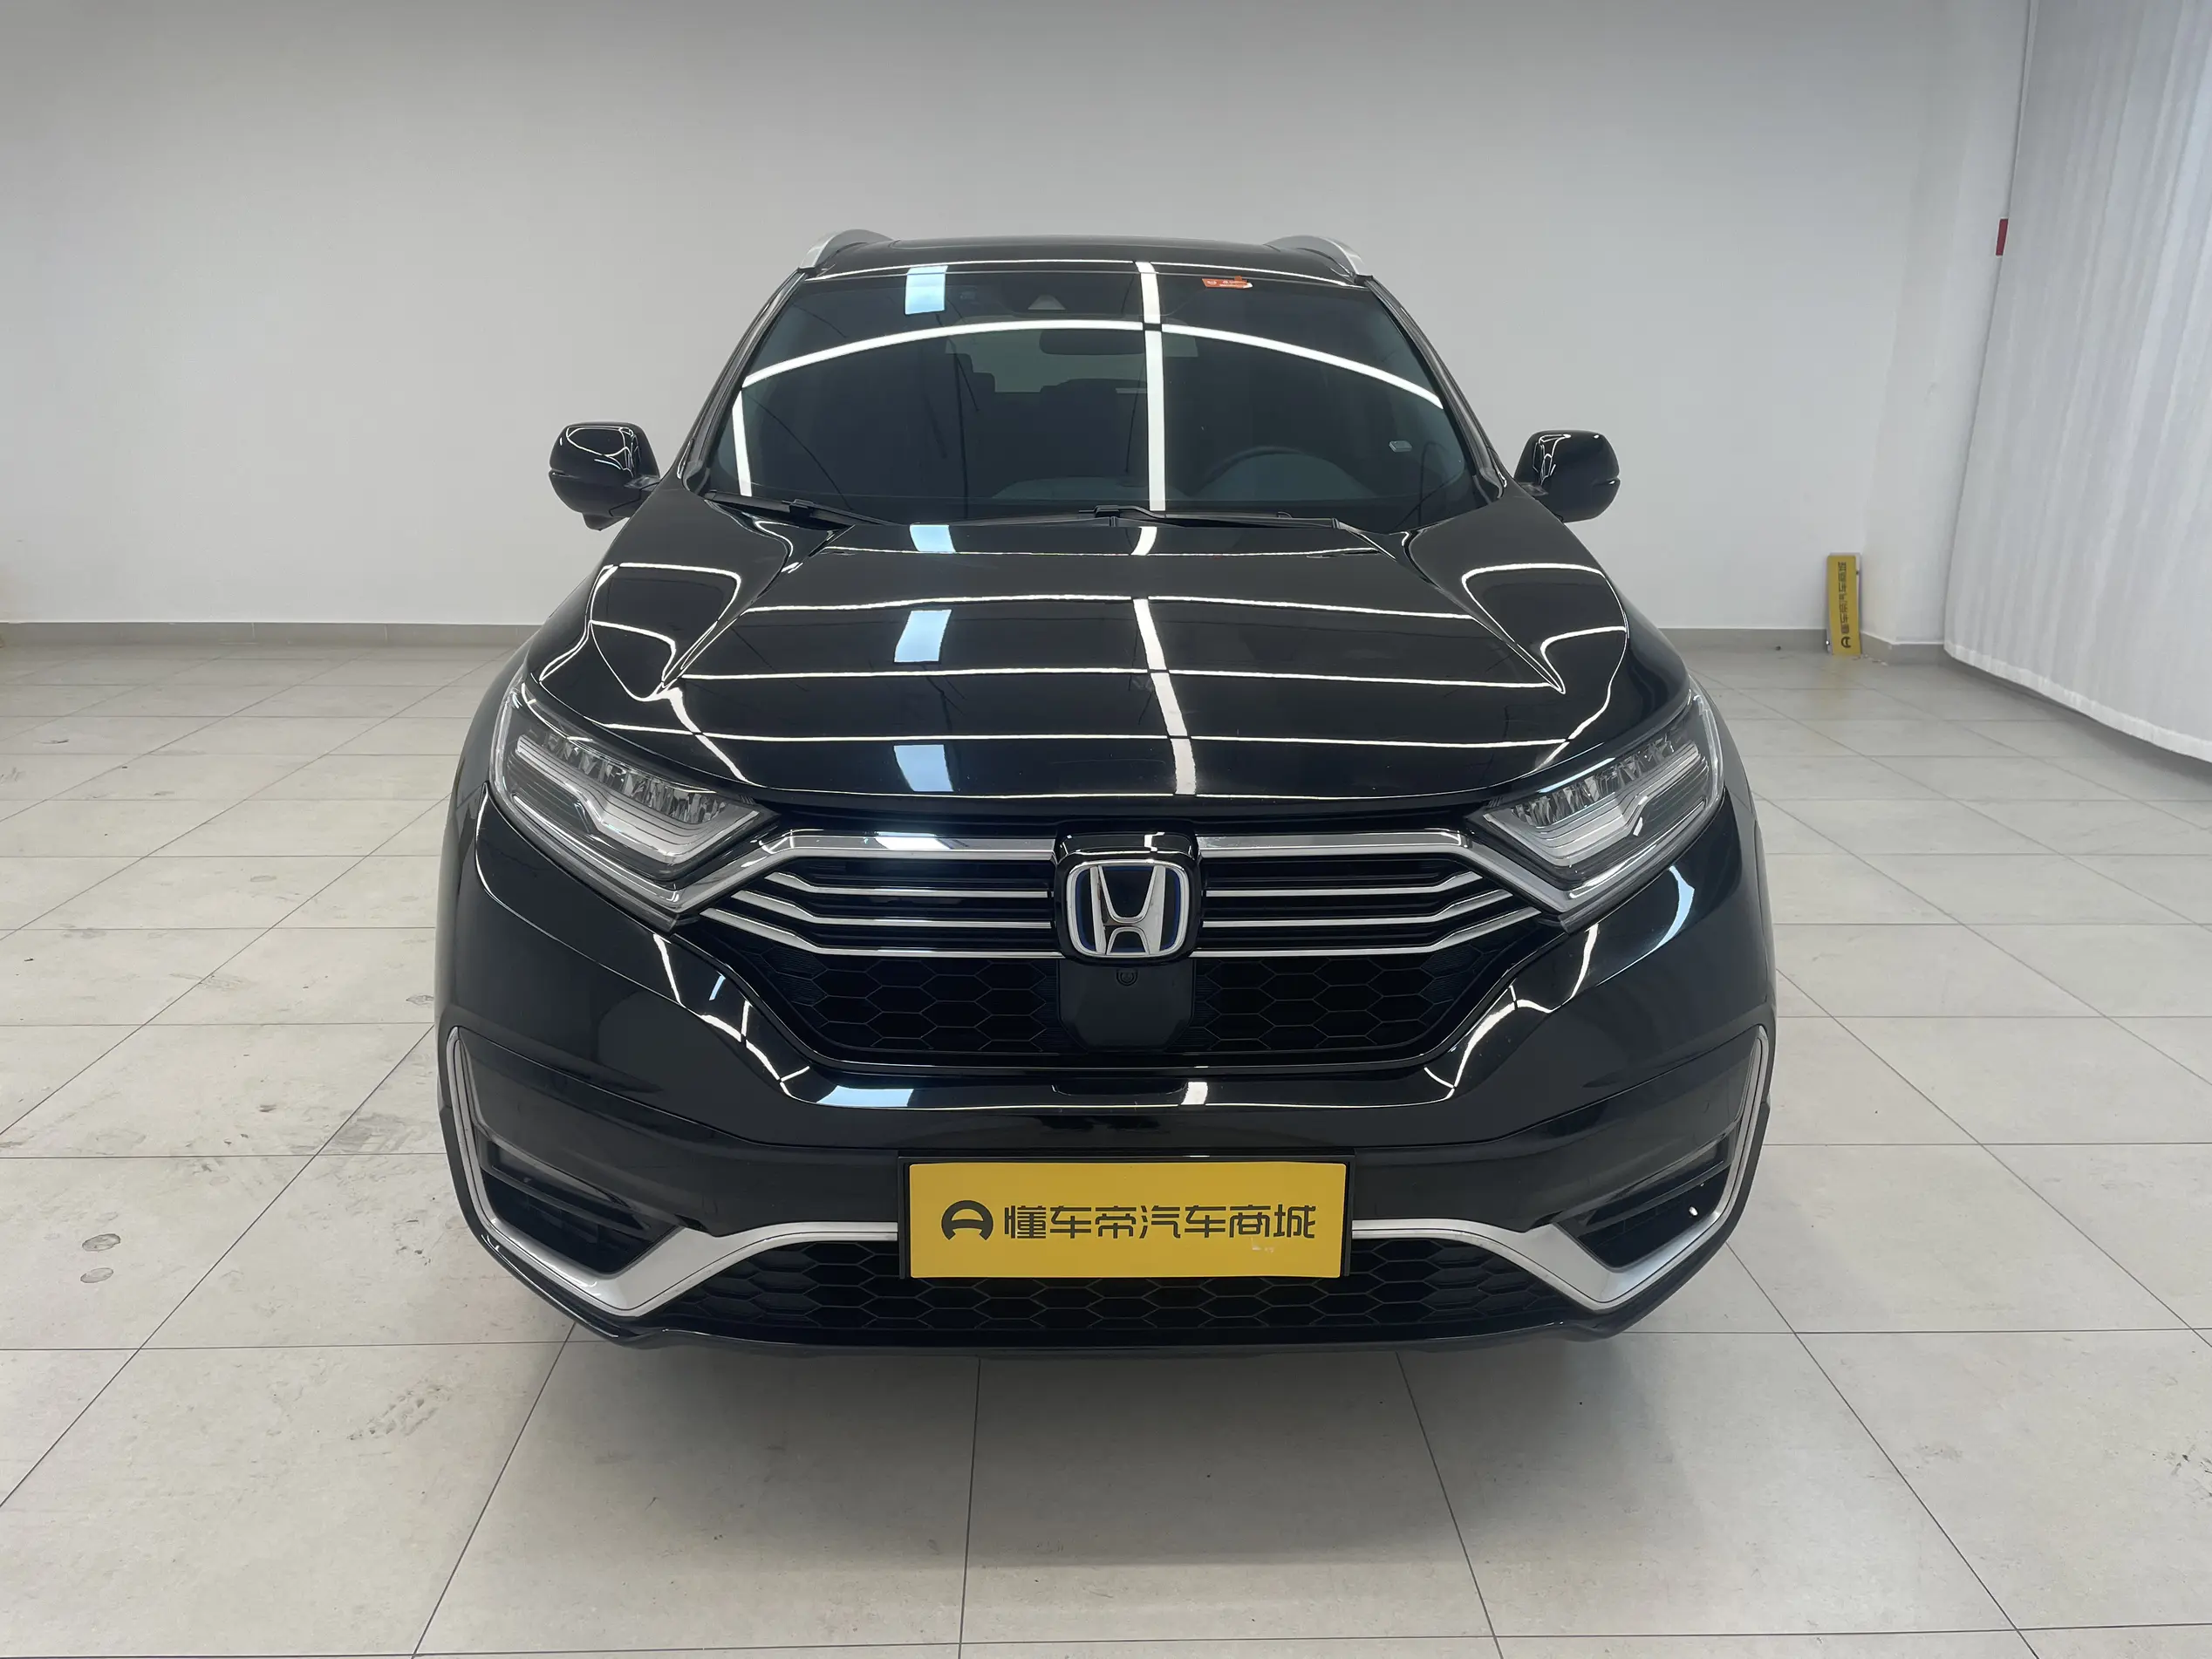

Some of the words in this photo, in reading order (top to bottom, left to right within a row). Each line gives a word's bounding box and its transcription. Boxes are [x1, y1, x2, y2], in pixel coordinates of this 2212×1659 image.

[1003, 1204, 1317, 1239] 懂车帝汽车商城
